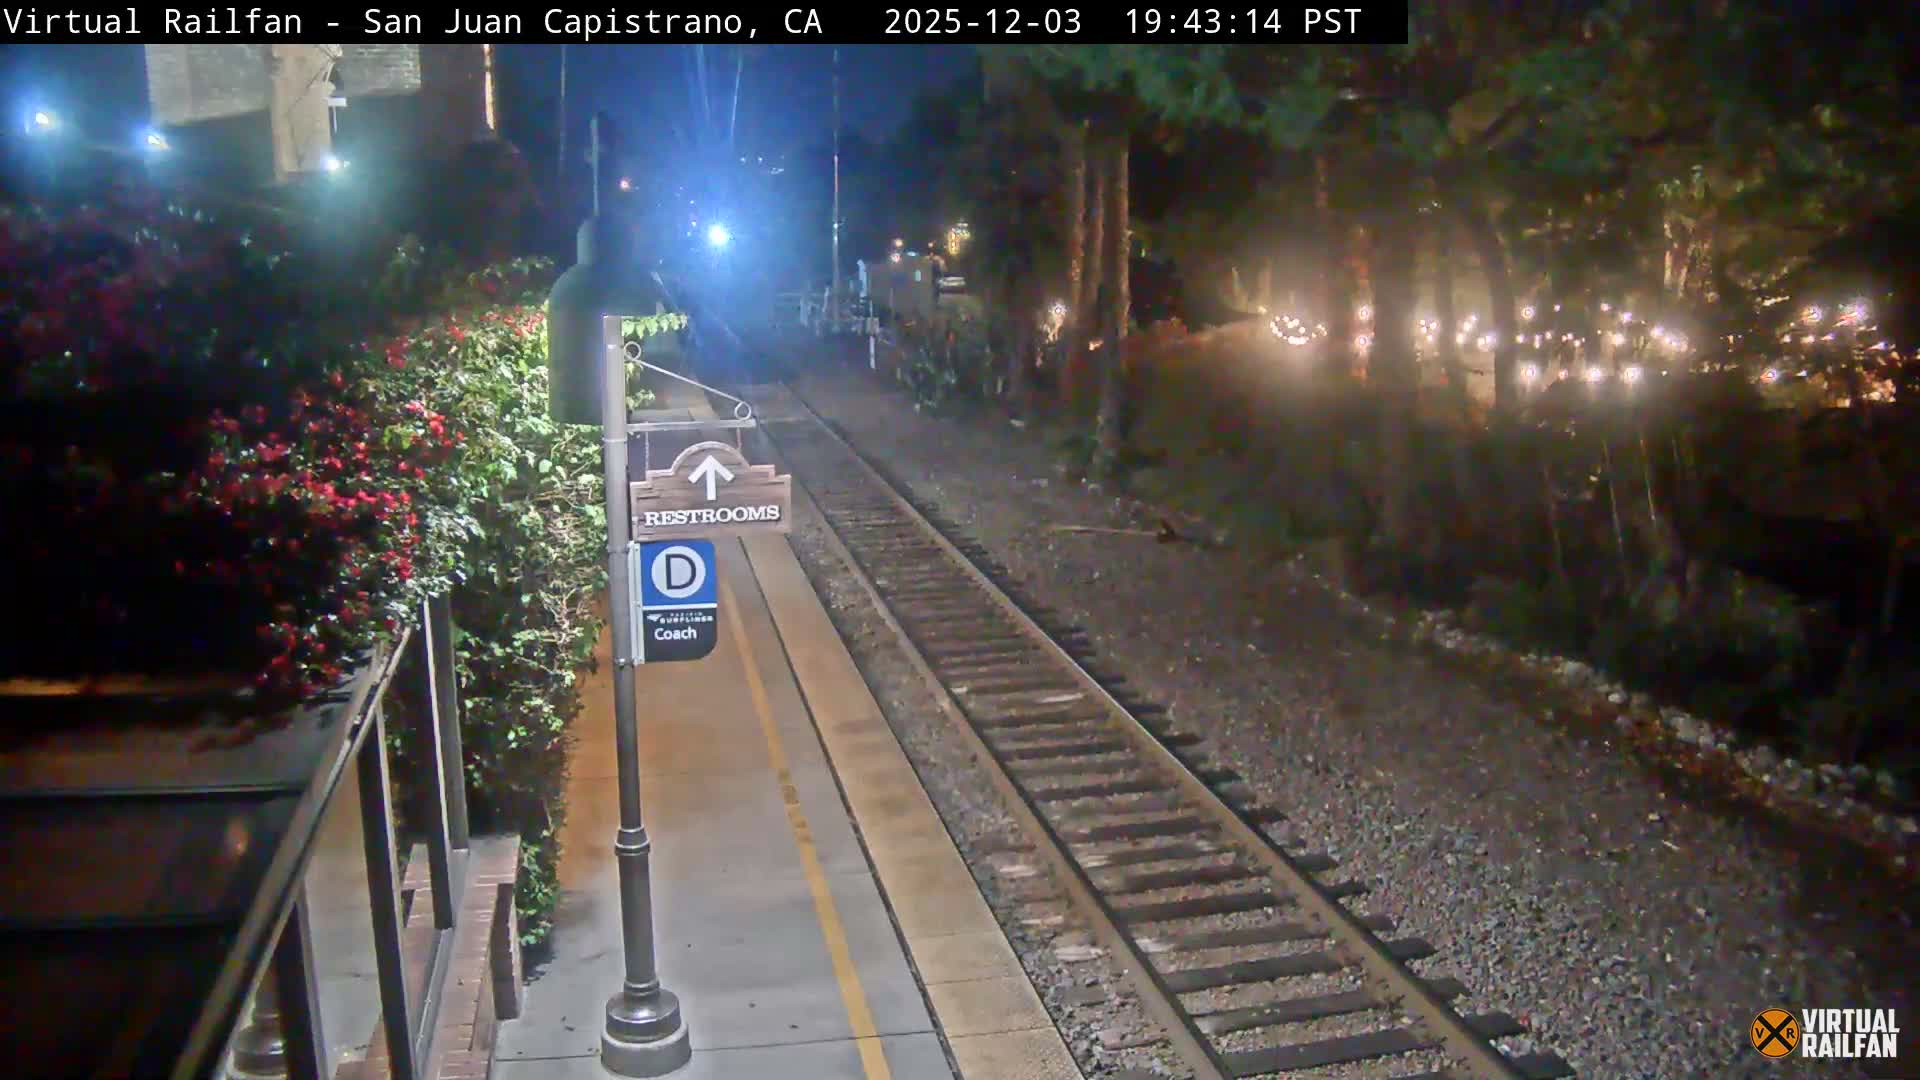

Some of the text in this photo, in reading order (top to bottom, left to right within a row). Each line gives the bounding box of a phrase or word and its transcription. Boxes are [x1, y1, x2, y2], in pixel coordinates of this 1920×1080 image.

[644, 505, 780, 526] RESTROOMS
[665, 553, 697, 590] D
[654, 626, 697, 640] Coach
